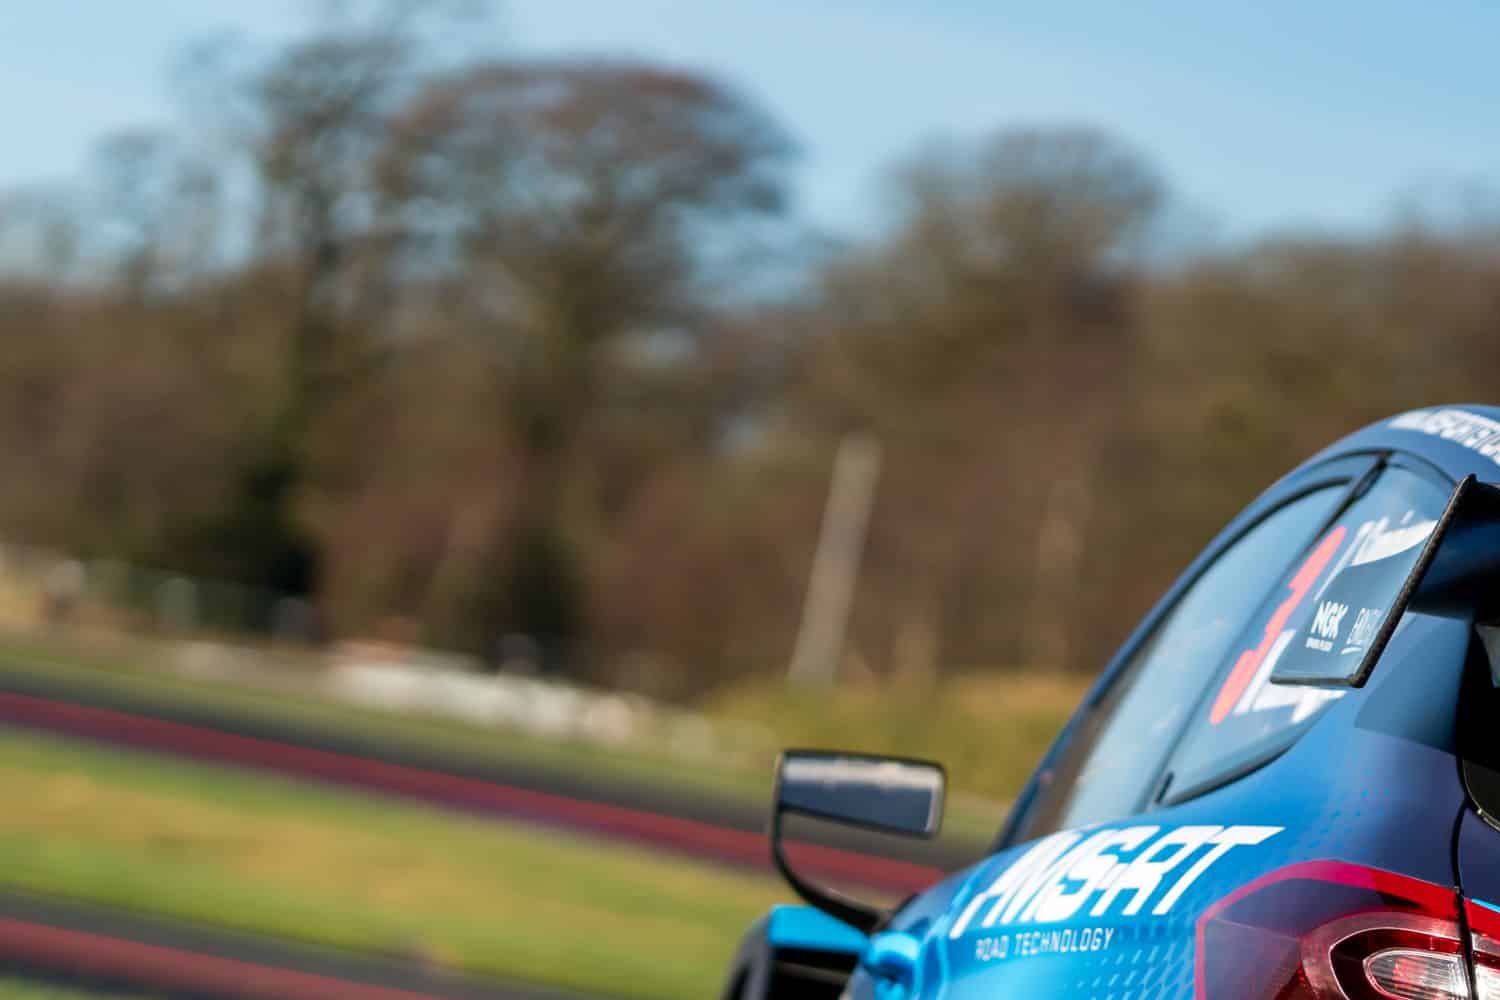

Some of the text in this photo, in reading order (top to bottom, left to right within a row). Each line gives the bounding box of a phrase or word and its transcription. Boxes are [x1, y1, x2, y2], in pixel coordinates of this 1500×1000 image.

[1311, 600, 1348, 639] NGK
[976, 927, 1114, 962] ROAD TECHNOLOGY
